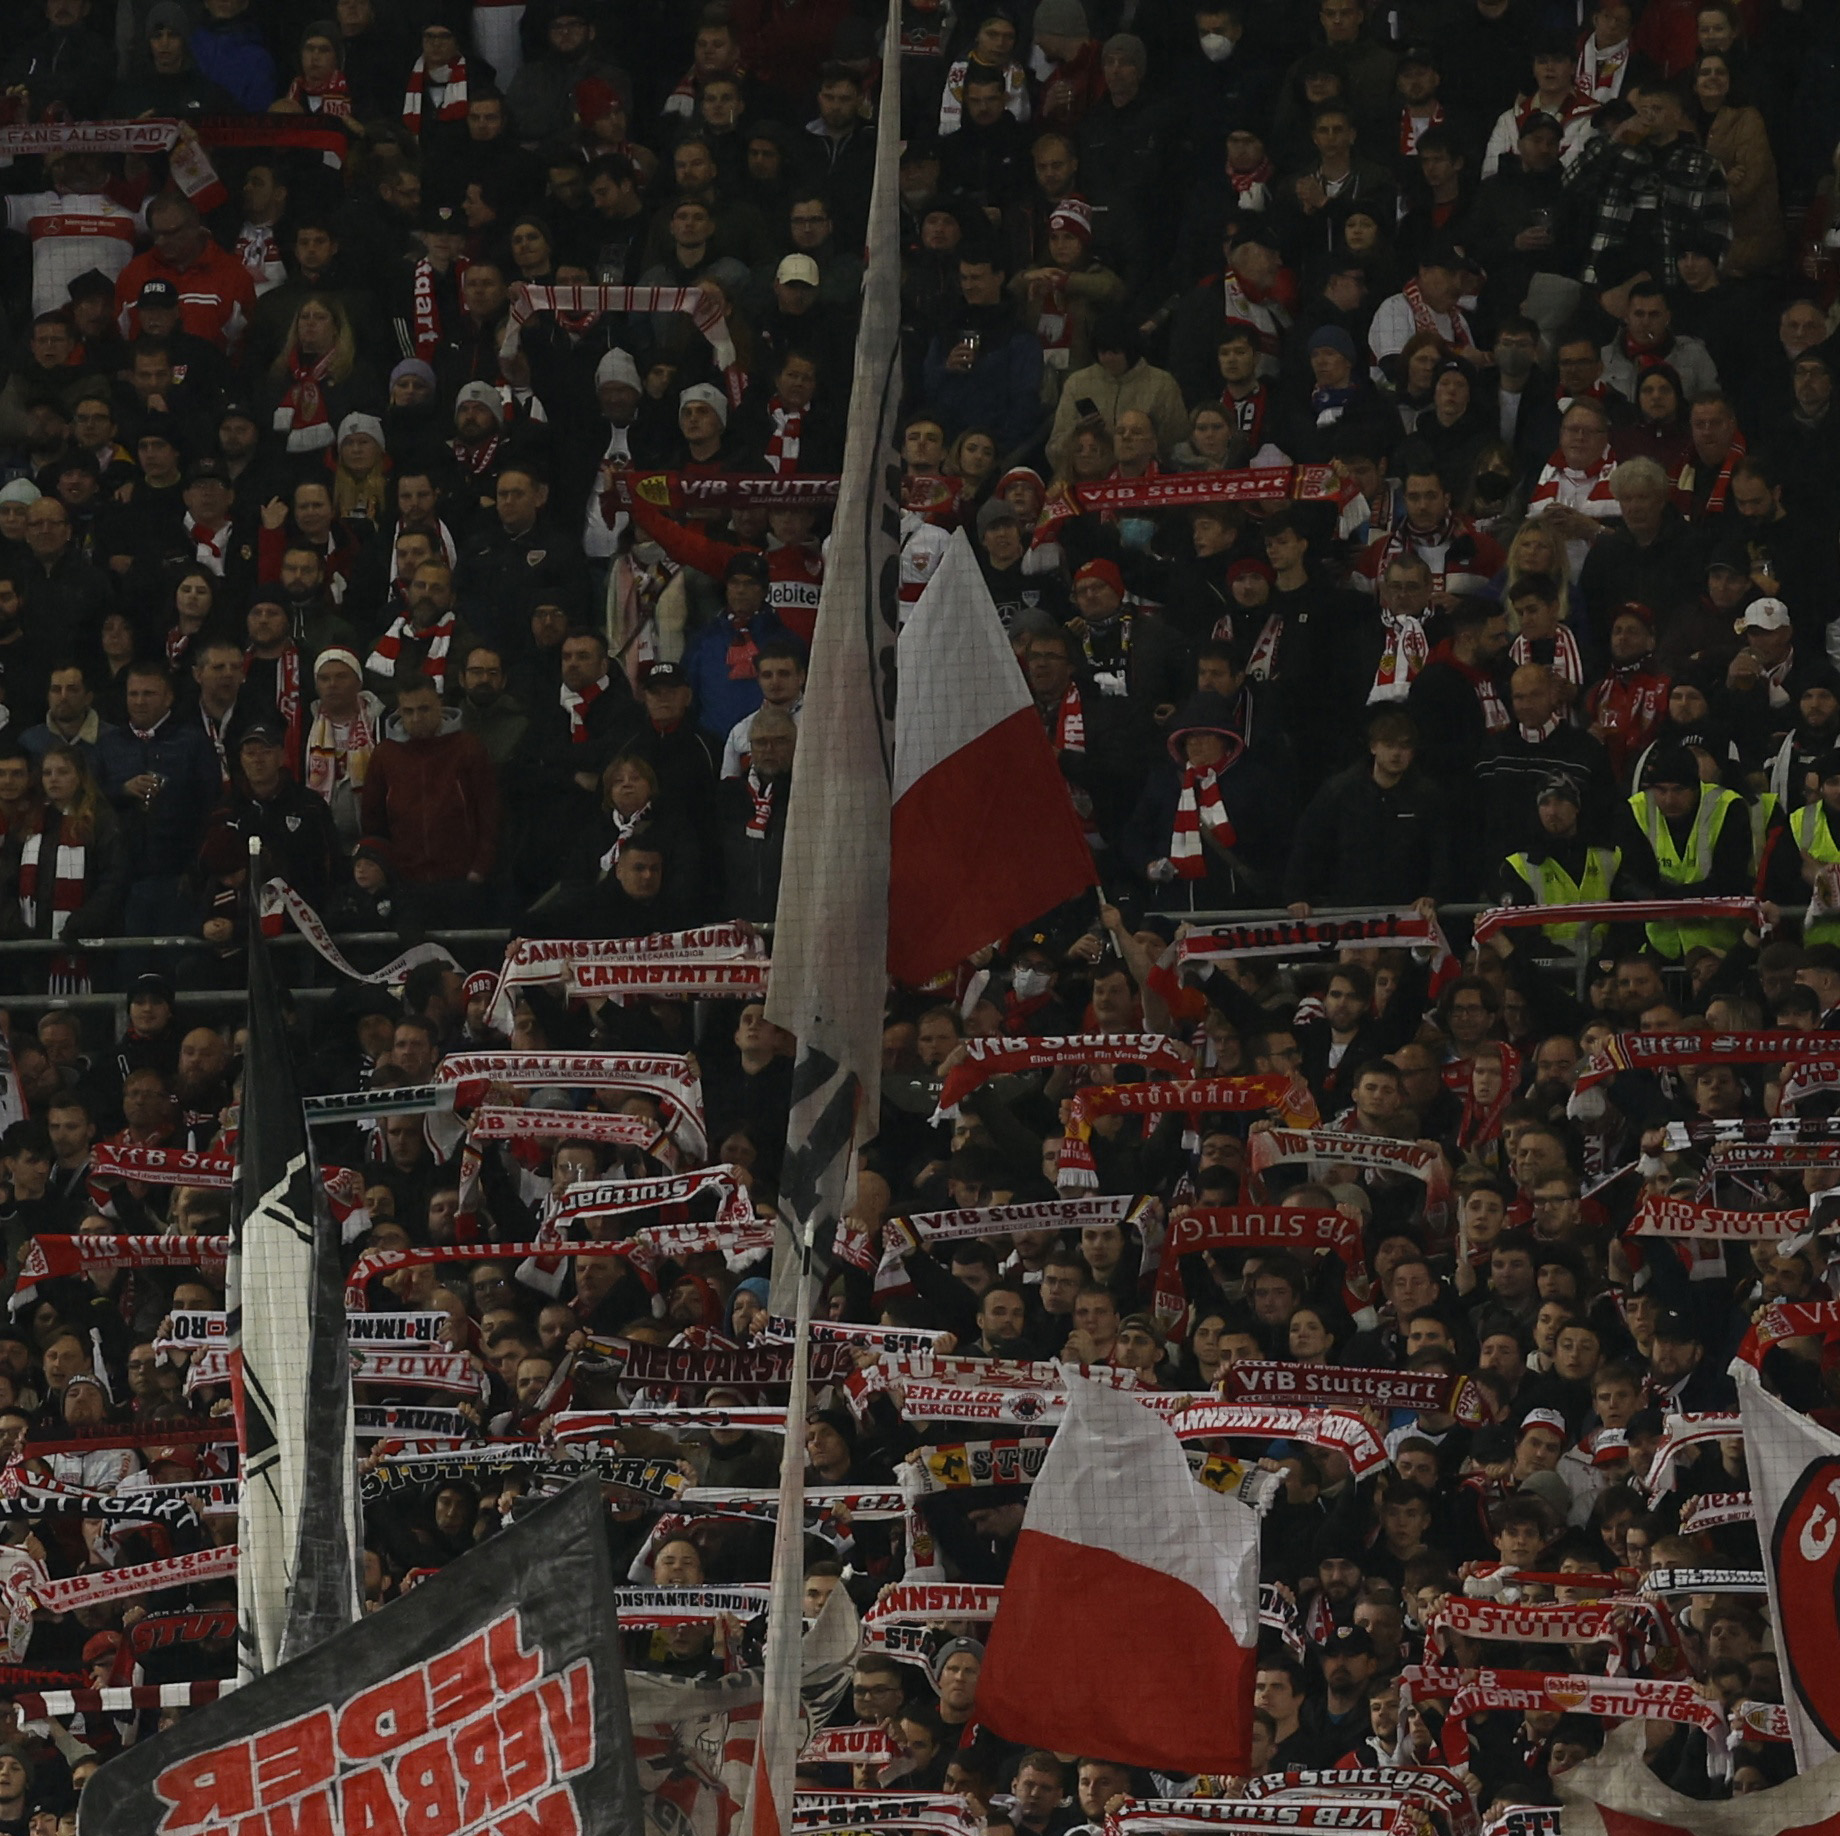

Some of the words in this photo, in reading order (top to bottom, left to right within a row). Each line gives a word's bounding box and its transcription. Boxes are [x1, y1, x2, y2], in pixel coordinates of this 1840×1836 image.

[13, 127, 62, 148] FANS
[67, 125, 175, 148] ALBSTADT
[679, 478, 730, 498] VfB
[1082, 487, 1116, 505] VfB
[1126, 477, 1287, 502] Stuttgart
[516, 930, 682, 967] CANNSTATTER
[1210, 916, 1398, 951] Stuttgart
[104, 1145, 163, 1168] VfB
[921, 1207, 980, 1231] VfB
[987, 1198, 1128, 1223] Stuttgart
[1236, 1370, 1297, 1393] VfB
[1303, 1372, 1438, 1402] Stuttgart
[703, 1592, 736, 1610] SIND
[1589, 1695, 1721, 1729] STUTTGART
